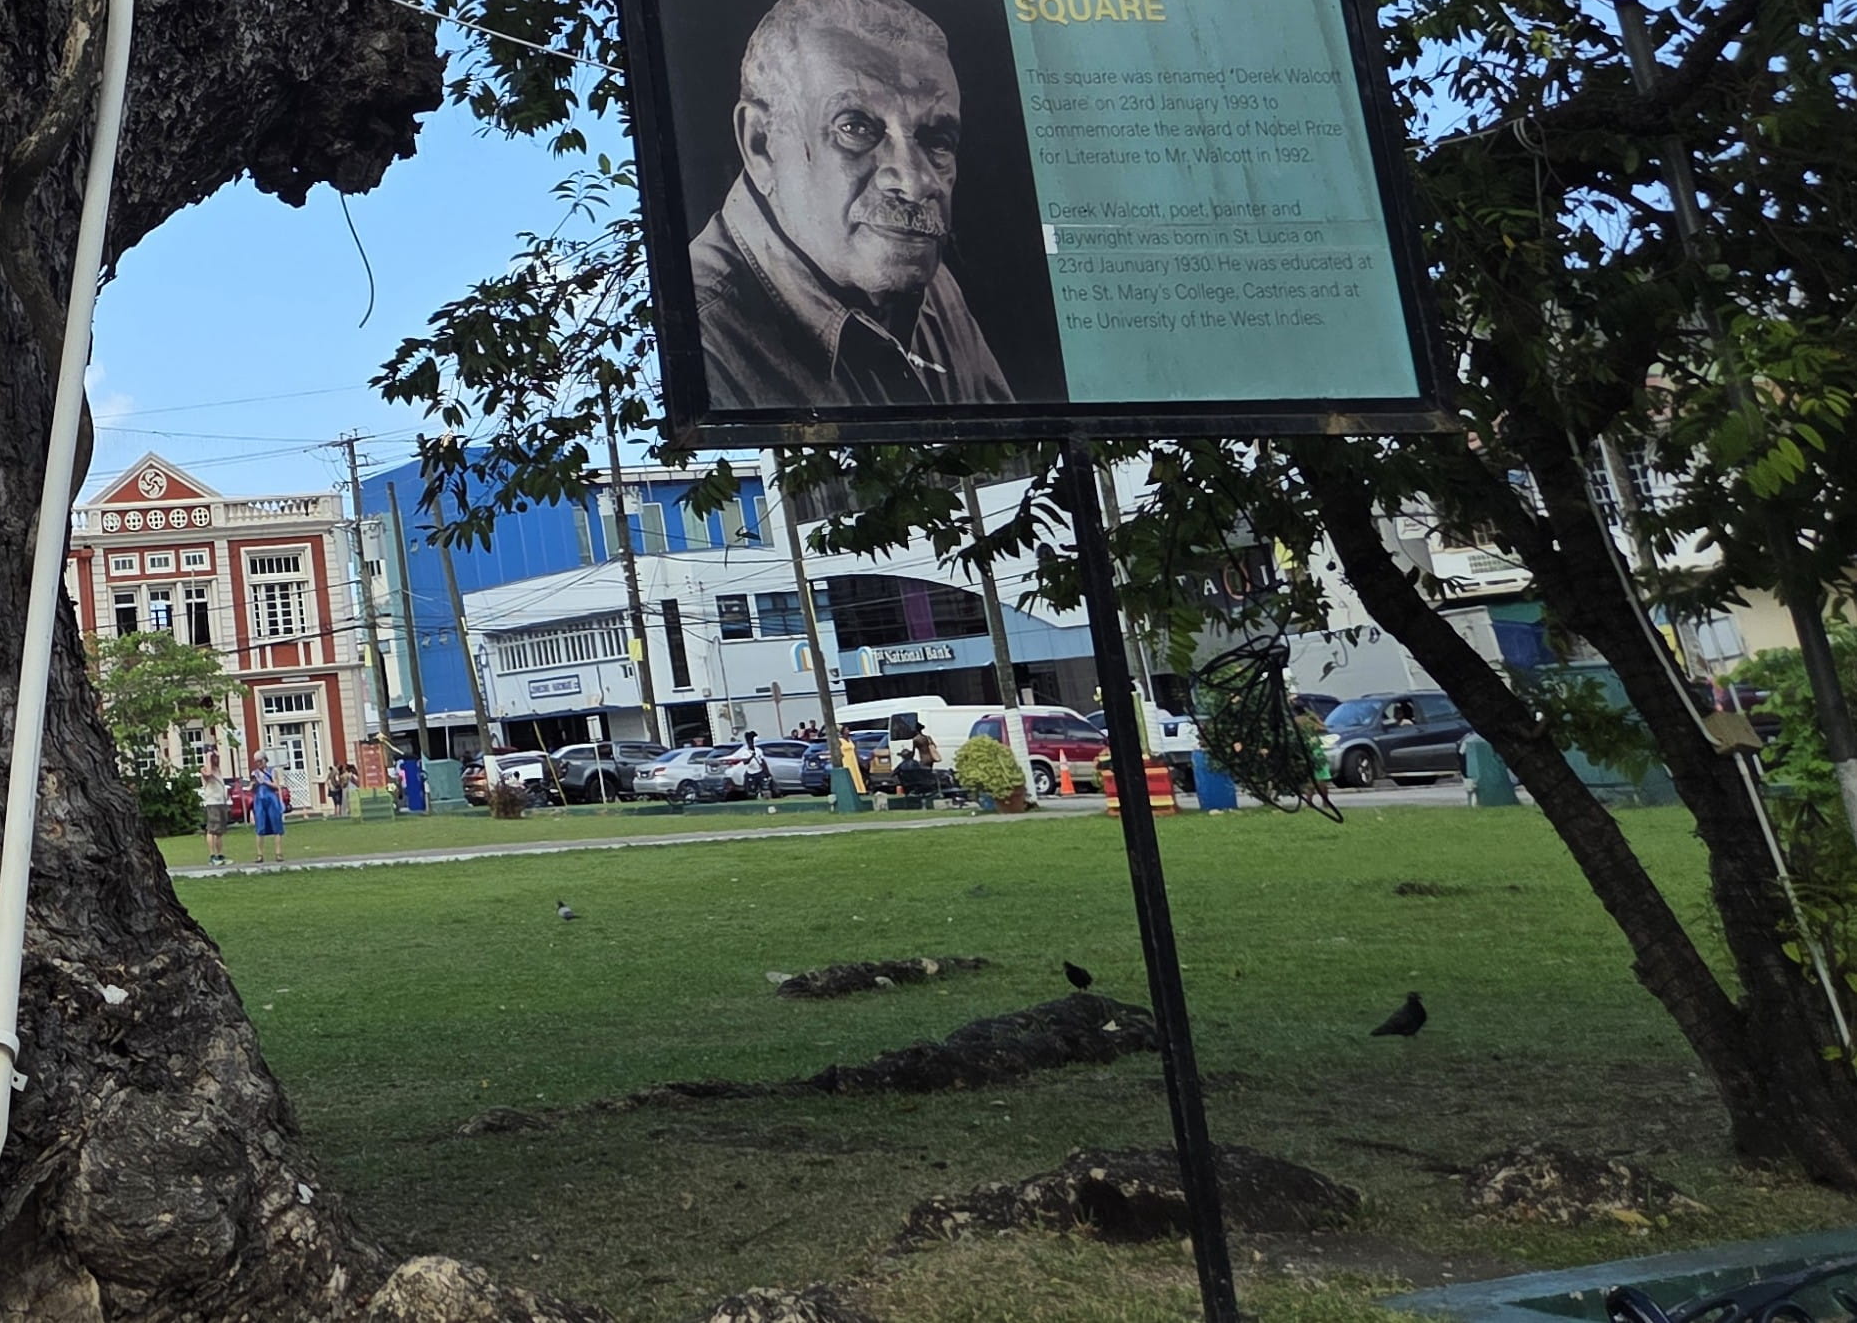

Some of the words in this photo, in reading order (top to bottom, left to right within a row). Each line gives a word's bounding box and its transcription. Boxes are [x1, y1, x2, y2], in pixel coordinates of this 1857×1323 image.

[1026, 68, 1060, 85] This
[1064, 70, 1118, 87] square
[1121, 70, 1153, 85] was
[1157, 68, 1225, 85] renamed
[1284, 68, 1342, 85] Walcott
[1095, 97, 1115, 111] on
[1119, 95, 1155, 111] 23rd
[1160, 95, 1218, 114] January
[1223, 94, 1259, 110] 1993
[1263, 96, 1279, 110] to
[1035, 122, 1150, 138] commemorate
[1154, 120, 1180, 137] the
[1184, 120, 1232, 137] award
[1236, 120, 1251, 136] of
[1255, 120, 1302, 136] Nobel
[1305, 120, 1342, 137] Prize
[1039, 148, 1061, 165] for
[1065, 148, 1140, 165] Literature
[1144, 148, 1161, 164] to
[1165, 148, 1189, 164] Mr.
[1193, 147, 1252, 164] Walcott
[1256, 147, 1271, 163] in
[1275, 147, 1315, 163] 1992.
[1048, 202, 1096, 219] Derek
[1100, 202, 1165, 219] Walcott,
[1169, 203, 1209, 220] poet,
[1213, 202, 1267, 220] painter
[1272, 199, 1302, 217] and
[1137, 232, 1169, 245] was
[1174, 228, 1209, 245] born
[1215, 228, 1229, 244] in
[1233, 228, 1254, 244] St.
[1257, 228, 1300, 244] Lucia
[1304, 229, 1324, 243] on
[1057, 257, 1094, 274] 23rd
[1099, 256, 1169, 276] Jaunuary
[1174, 256, 1214, 273] 1930.
[1217, 255, 1241, 271] He
[1245, 258, 1277, 272] was
[1281, 253, 1353, 271] educated
[1358, 255, 1374, 270] at
[1062, 285, 1088, 302] the
[1092, 284, 1114, 301] St.
[1117, 283, 1171, 305] Mary's
[1174, 282, 1240, 304] College,
[1243, 281, 1306, 300] Castries
[1310, 281, 1340, 298] and
[1344, 282, 1360, 298] at
[1066, 312, 1093, 329] the
[1097, 310, 1176, 332] University
[1181, 310, 1196, 327] of
[1200, 310, 1226, 327] the
[1229, 310, 1271, 328] West
[1275, 309, 1325, 326] Indies.
[885, 647, 925, 664] National
[925, 644, 953, 661] Bank
